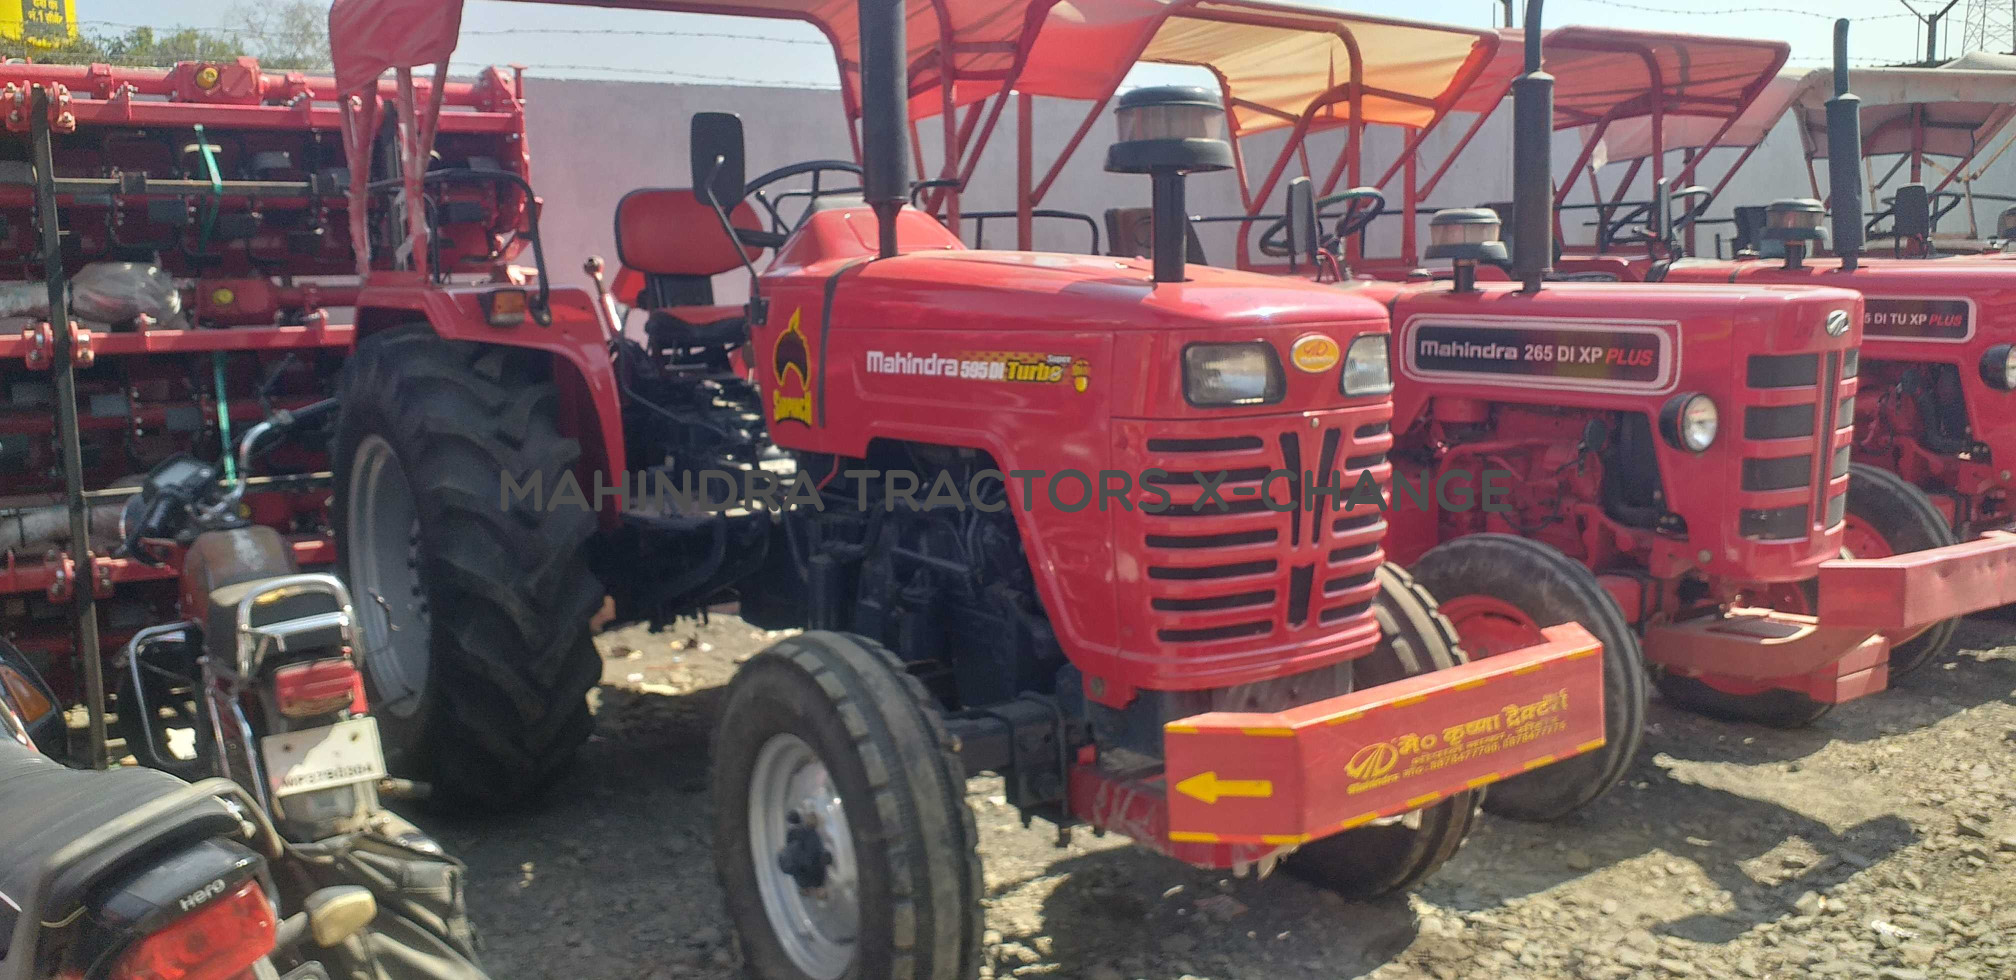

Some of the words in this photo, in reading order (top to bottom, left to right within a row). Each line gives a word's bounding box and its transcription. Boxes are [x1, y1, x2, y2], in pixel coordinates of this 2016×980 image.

[1874, 313, 1887, 325] DI
[1890, 313, 1907, 325] TU
[1910, 313, 1927, 326] XP
[1929, 314, 1963, 327] PLUS
[866, 350, 959, 377] Mahindra
[1006, 359, 1065, 382] Turbo
[1420, 340, 1518, 360] Mahindra
[1524, 344, 1553, 362] 265
[1557, 345, 1575, 363] DI
[1578, 346, 1603, 364] XP
[1605, 348, 1653, 366] PLUS
[178, 878, 227, 912] Hero
